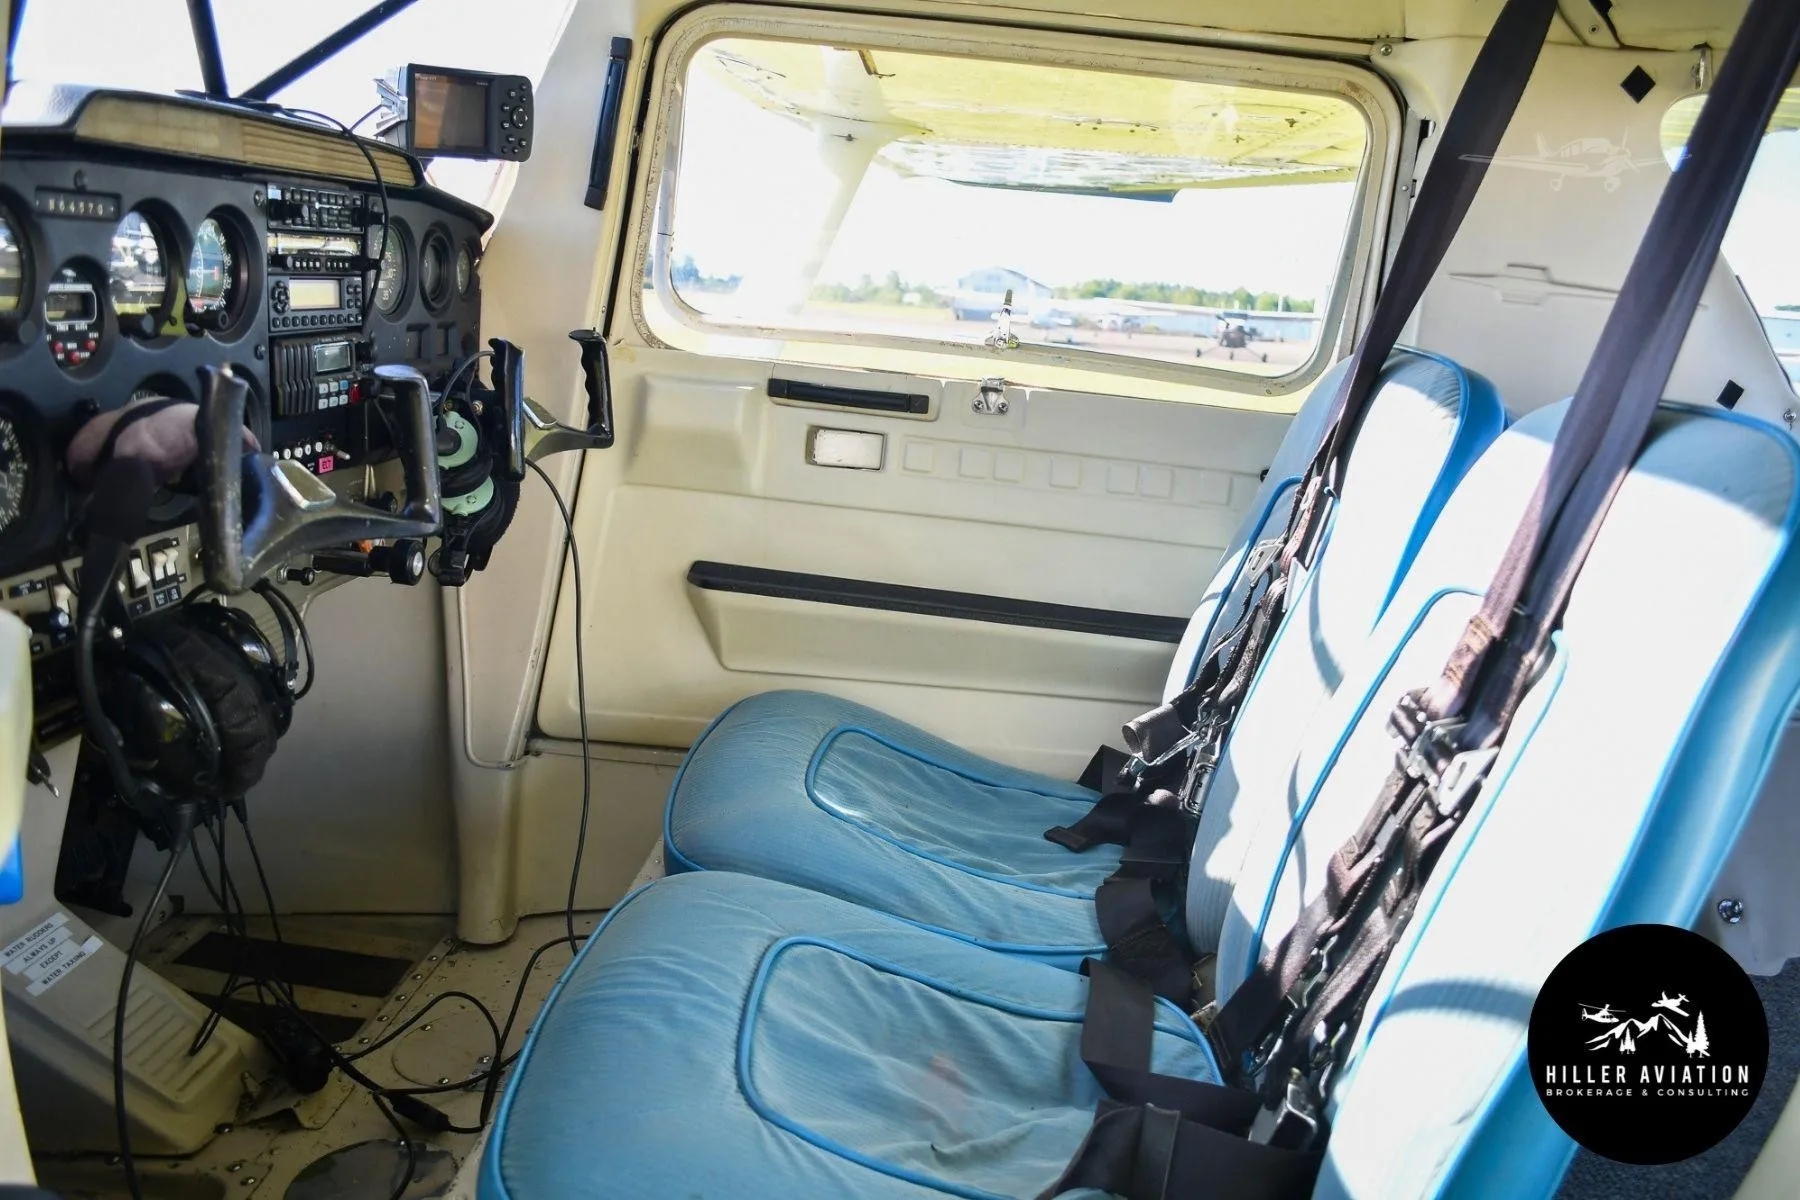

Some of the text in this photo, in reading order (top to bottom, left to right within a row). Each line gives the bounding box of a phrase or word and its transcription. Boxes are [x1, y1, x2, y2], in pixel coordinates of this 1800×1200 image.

[5, 922, 54, 958] WATER RUDDERS
[23, 936, 57, 963] ALWAYS UP
[42, 968, 62, 985] WATER
